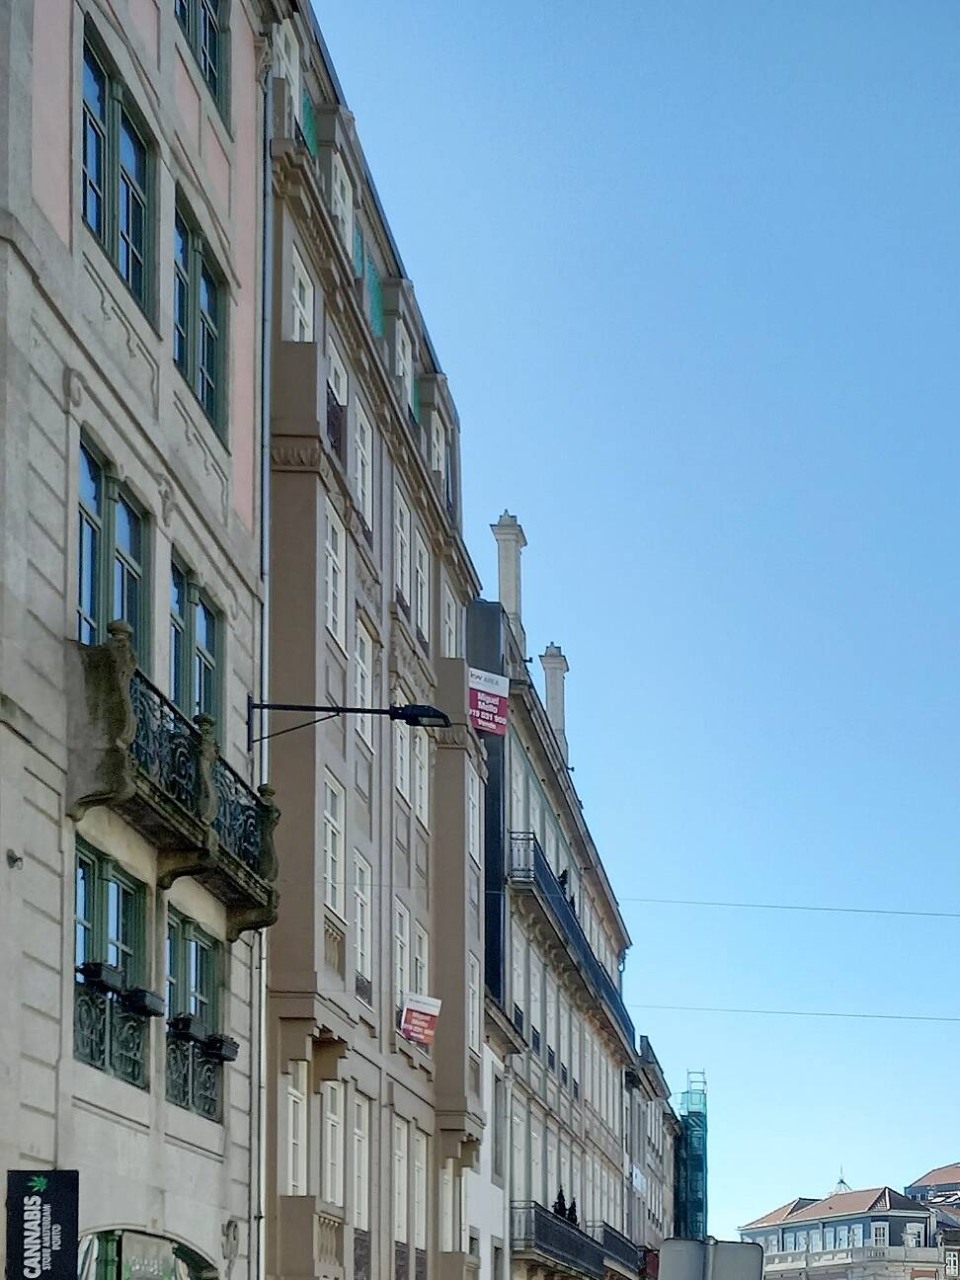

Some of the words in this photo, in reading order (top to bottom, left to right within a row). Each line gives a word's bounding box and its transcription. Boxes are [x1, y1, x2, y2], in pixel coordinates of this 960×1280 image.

[23, 1195, 42, 1279] CANNABIS
[41, 1203, 52, 1246] AMSTERDAM
[51, 1223, 62, 1251] PORTO
[41, 1247, 52, 1271] STORE
